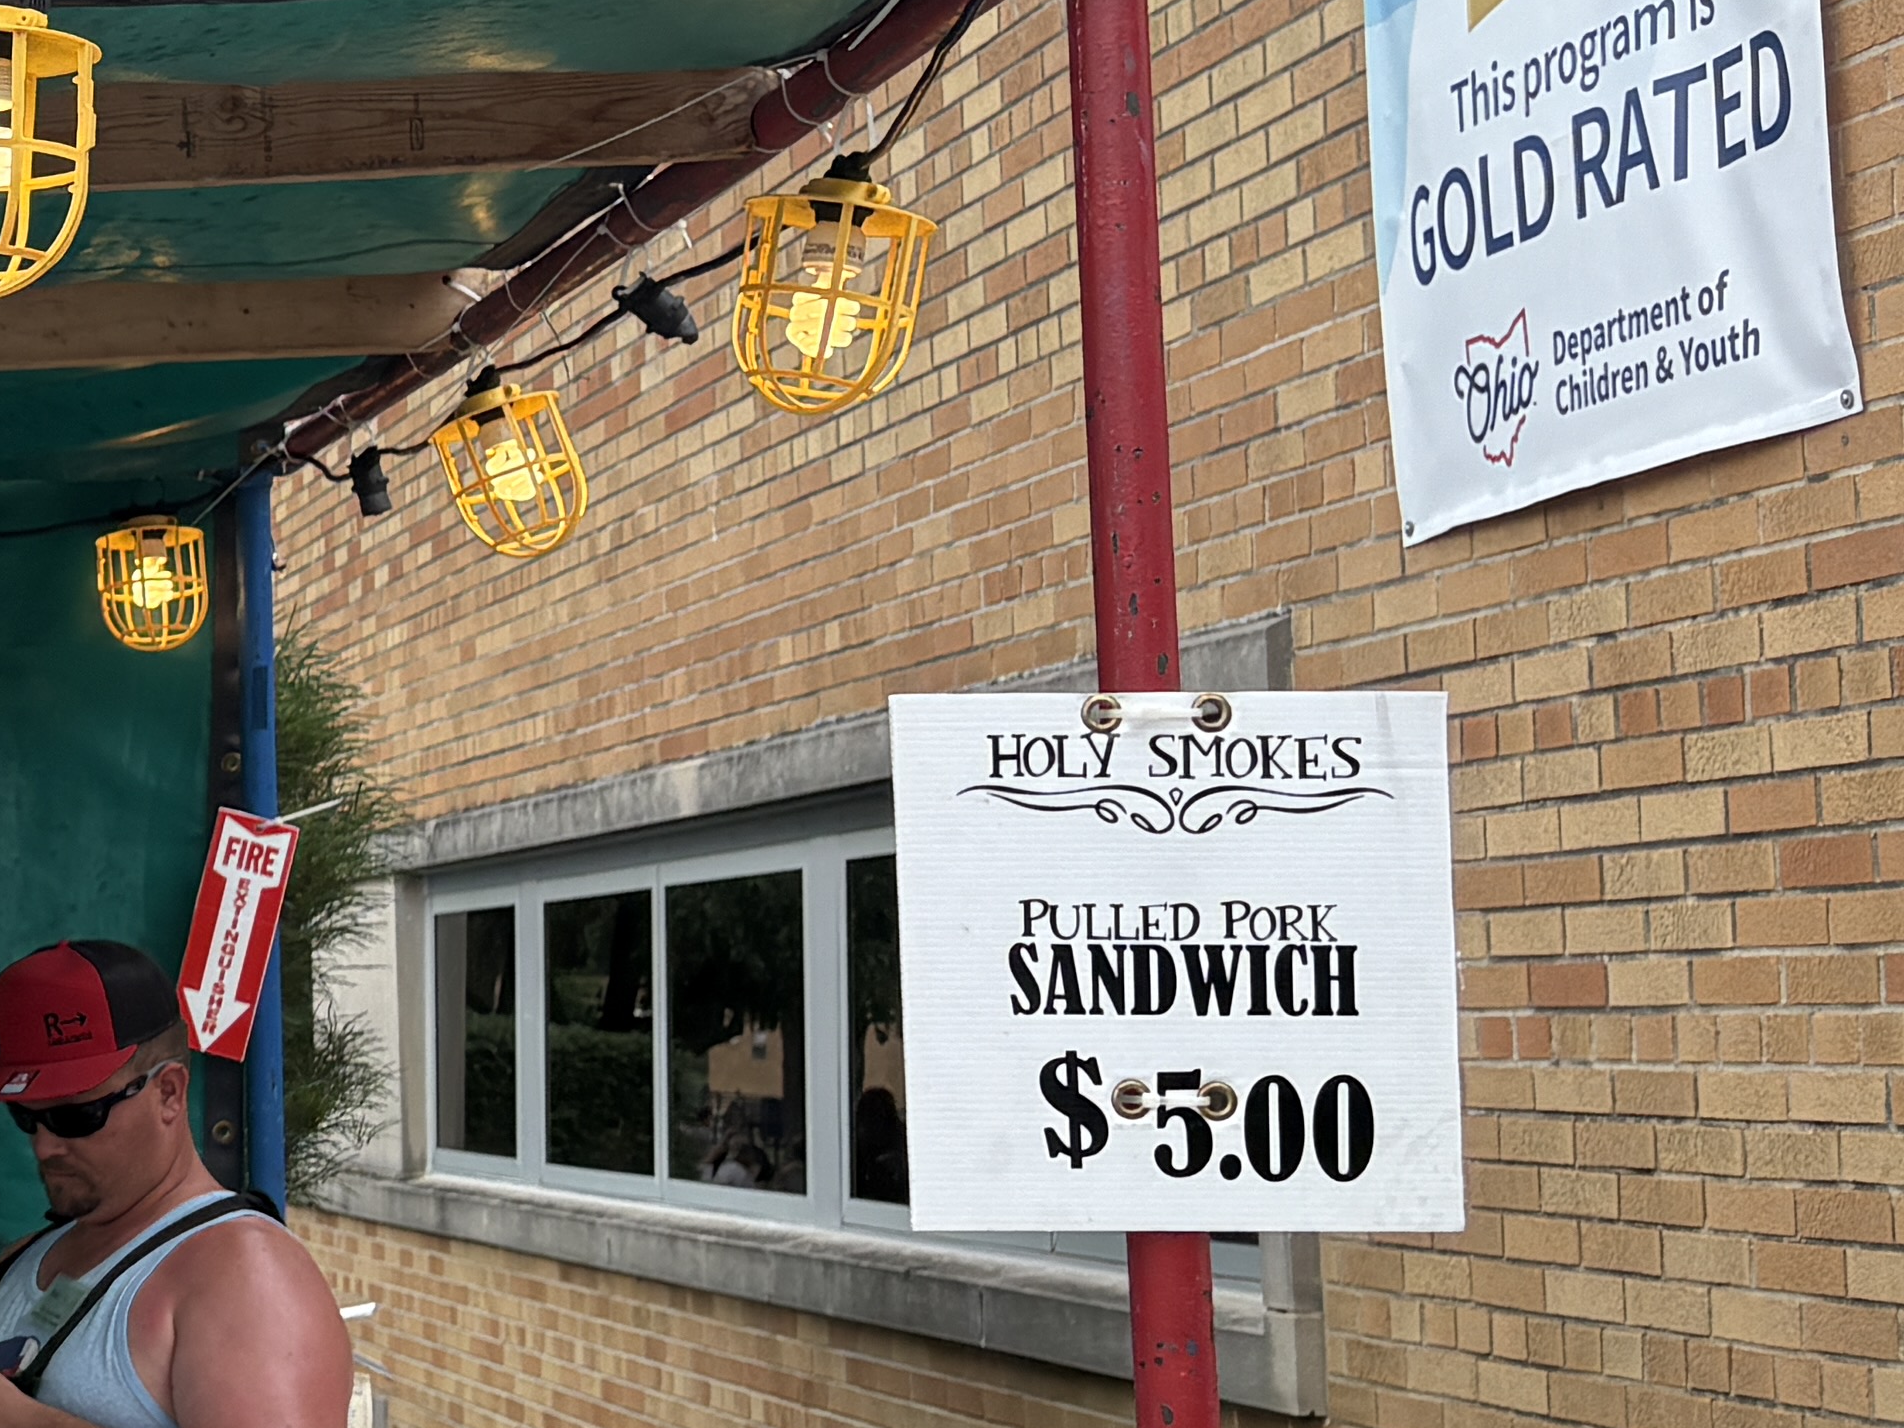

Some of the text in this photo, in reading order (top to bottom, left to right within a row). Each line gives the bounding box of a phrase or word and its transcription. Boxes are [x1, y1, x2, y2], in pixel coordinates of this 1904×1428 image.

[1451, 58, 1517, 134] This
[1409, 29, 1793, 287] GOLD RATED
[1553, 269, 1730, 366] Department of
[1454, 355, 1539, 444] Ohio
[1555, 319, 1760, 415] Children & Youth
[987, 733, 1362, 780] HOLY SMOKES
[222, 836, 280, 878] FIRE
[202, 877, 251, 1036] EXTINGUISHER
[1019, 899, 1338, 942] PULLED PORK
[1008, 943, 1359, 1017] SANDWICH
